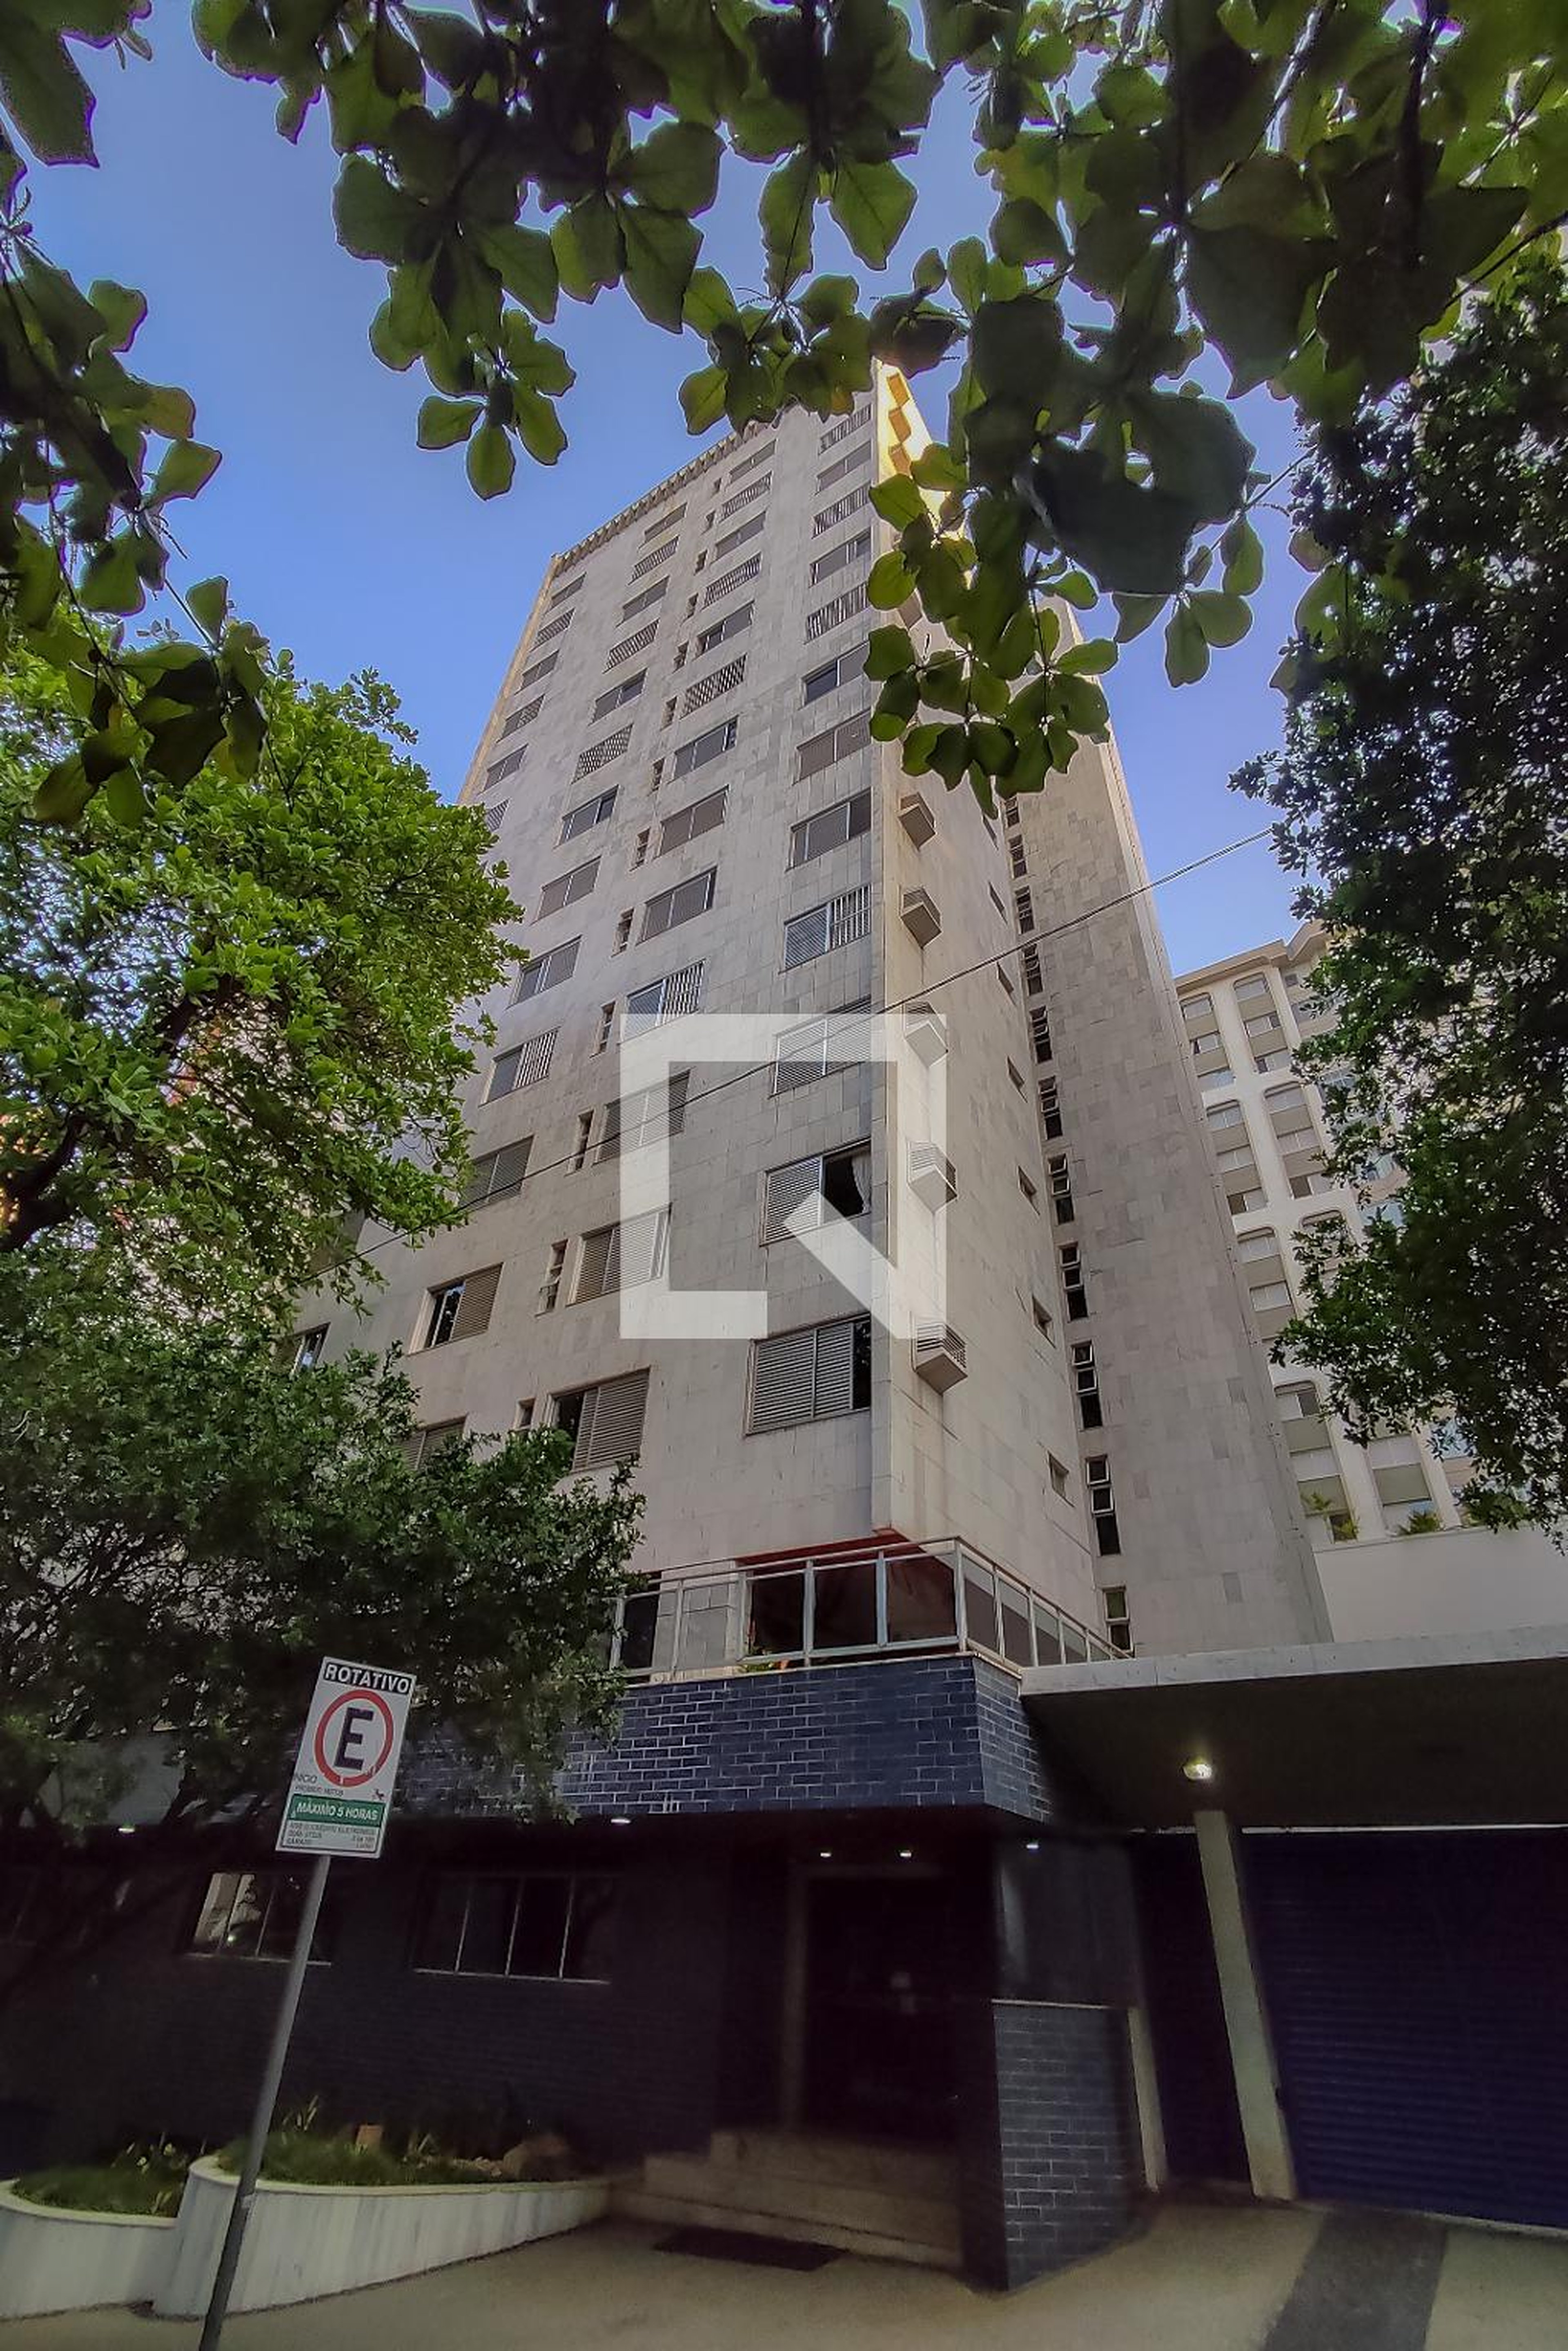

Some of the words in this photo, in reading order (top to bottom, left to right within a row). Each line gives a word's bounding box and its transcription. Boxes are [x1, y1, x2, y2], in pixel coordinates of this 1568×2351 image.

[325, 1664, 409, 1693] ROTATIVO
[334, 1707, 374, 1770] E
[336, 1806, 344, 1817] 5
[345, 1807, 378, 1820] HORAS
